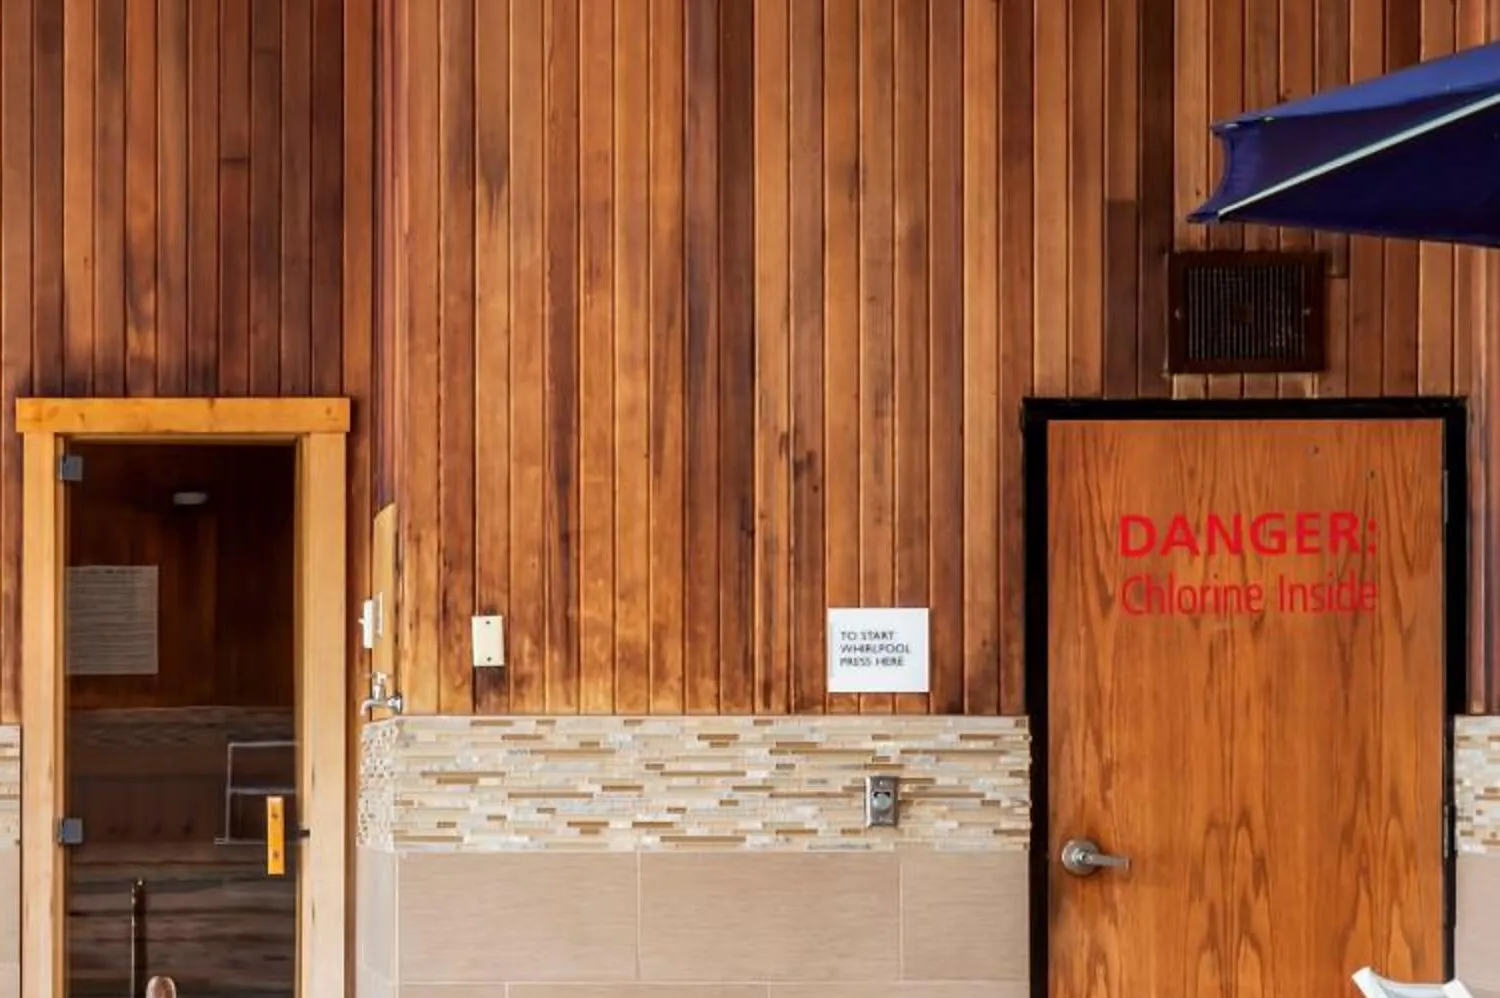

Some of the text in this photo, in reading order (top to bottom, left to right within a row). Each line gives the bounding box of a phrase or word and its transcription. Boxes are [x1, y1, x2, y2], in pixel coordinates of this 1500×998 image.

[1119, 511, 1378, 558] DANGER:
[1121, 569, 1378, 615] Chlorine Inside
[840, 631, 895, 641] TO START
[840, 643, 911, 654] WHIRLPOOL
[840, 657, 904, 667] PRESS HERE
